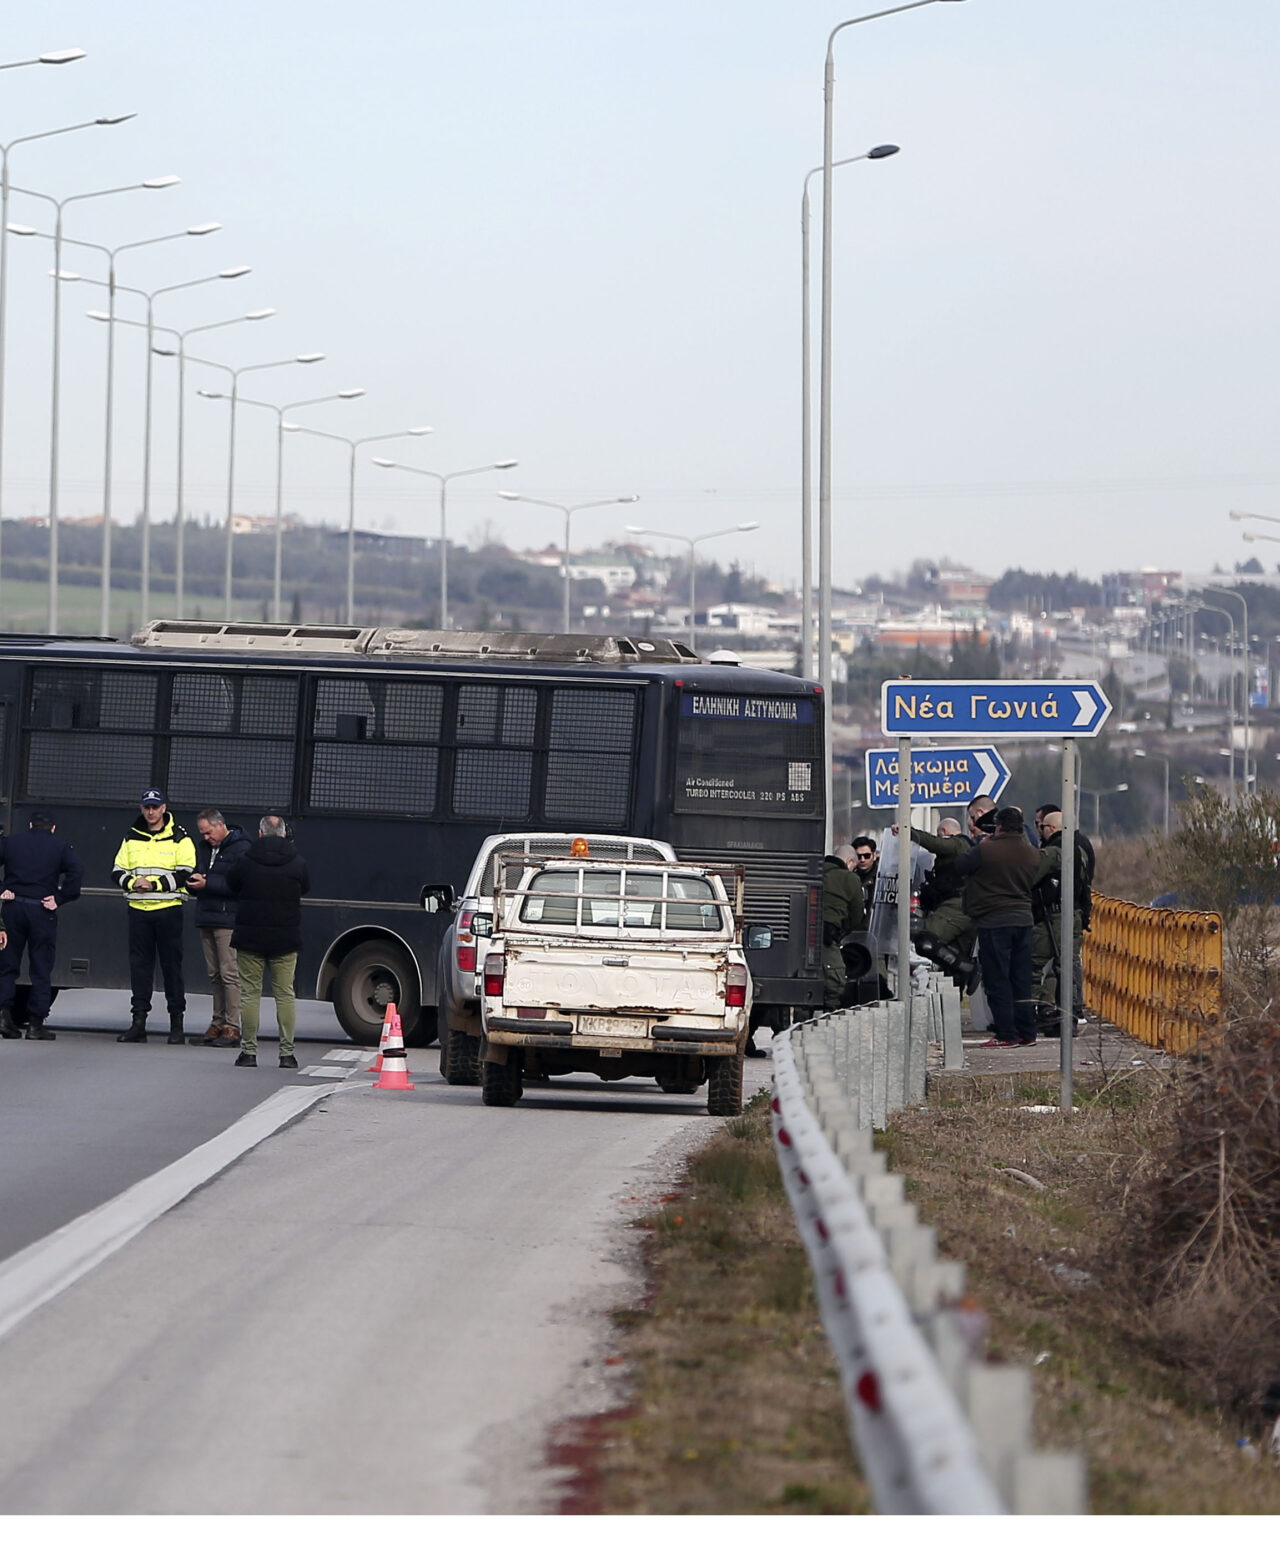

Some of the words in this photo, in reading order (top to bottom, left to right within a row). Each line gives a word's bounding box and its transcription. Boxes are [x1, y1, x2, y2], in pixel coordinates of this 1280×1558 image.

[693, 696, 740, 716] ΕΛΛΗΝΙΚΗ
[744, 699, 797, 720] ΑΣΤΥΝΟΜΙΑ
[894, 694, 955, 719] Νέα
[970, 693, 1059, 719] Γωνιά
[875, 757, 969, 776] Λάκωμα
[686, 777, 696, 786] Air
[686, 788, 708, 798] TURBO
[709, 789, 756, 800] INTERCOOLER
[760, 791, 773, 801] 220
[776, 792, 786, 801] PS
[790, 793, 804, 802] ABS
[530, 969, 697, 1001] TOYOTA
